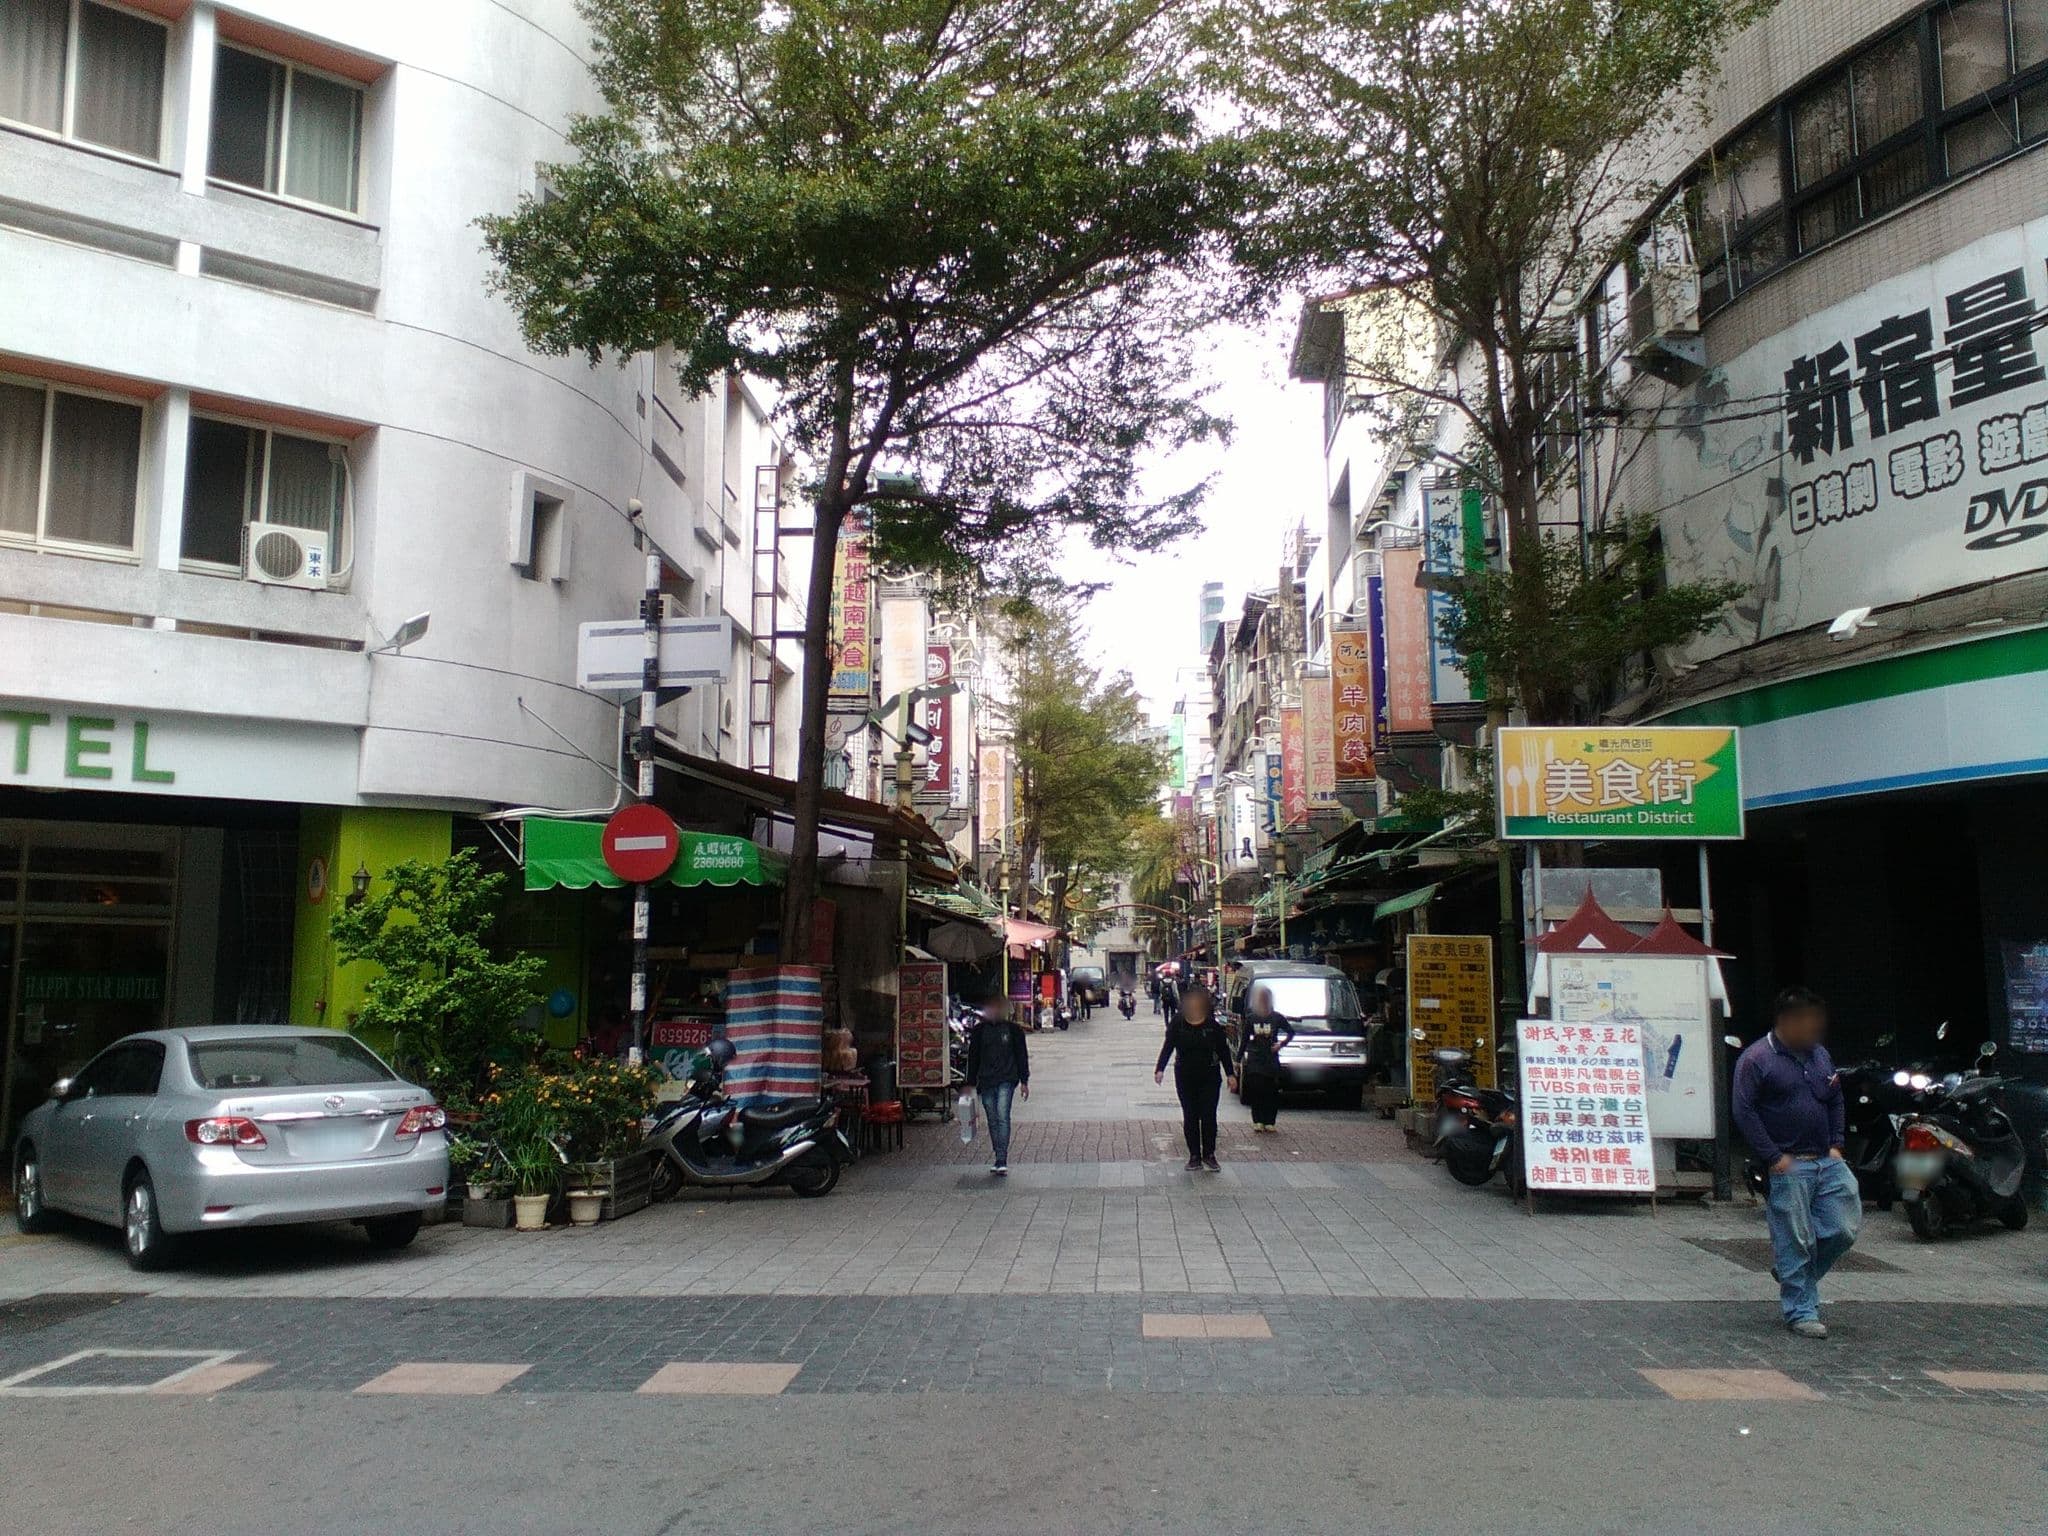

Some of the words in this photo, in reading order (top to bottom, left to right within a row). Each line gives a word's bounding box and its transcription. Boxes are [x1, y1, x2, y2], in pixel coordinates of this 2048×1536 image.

[1784, 262, 2048, 465] 新宿量
[1790, 459, 1877, 534] 日韓劇
[1889, 431, 1964, 499] 電影
[842, 540, 867, 668] 道地越南美食
[1340, 686, 1368, 761] 羊肉羹
[0, 710, 175, 783] TEL
[1544, 757, 1698, 806] 美食街
[1547, 811, 1633, 824] Restaurant
[1638, 811, 1695, 824] District
[1528, 1067, 1640, 1081] 感謝非凡電視台
[1528, 1080, 1641, 1095] TVBS食尚玩家
[1530, 1096, 1642, 1112] 三立台灣台
[1531, 1112, 1643, 1128] 蘋果美食王
[1545, 1129, 1645, 1145] 故鄉好滋味
[1550, 1147, 1632, 1165] 特別推薦
[1532, 1166, 1587, 1184] 肉蛋土司
[1622, 1168, 1650, 1185] 豆花
